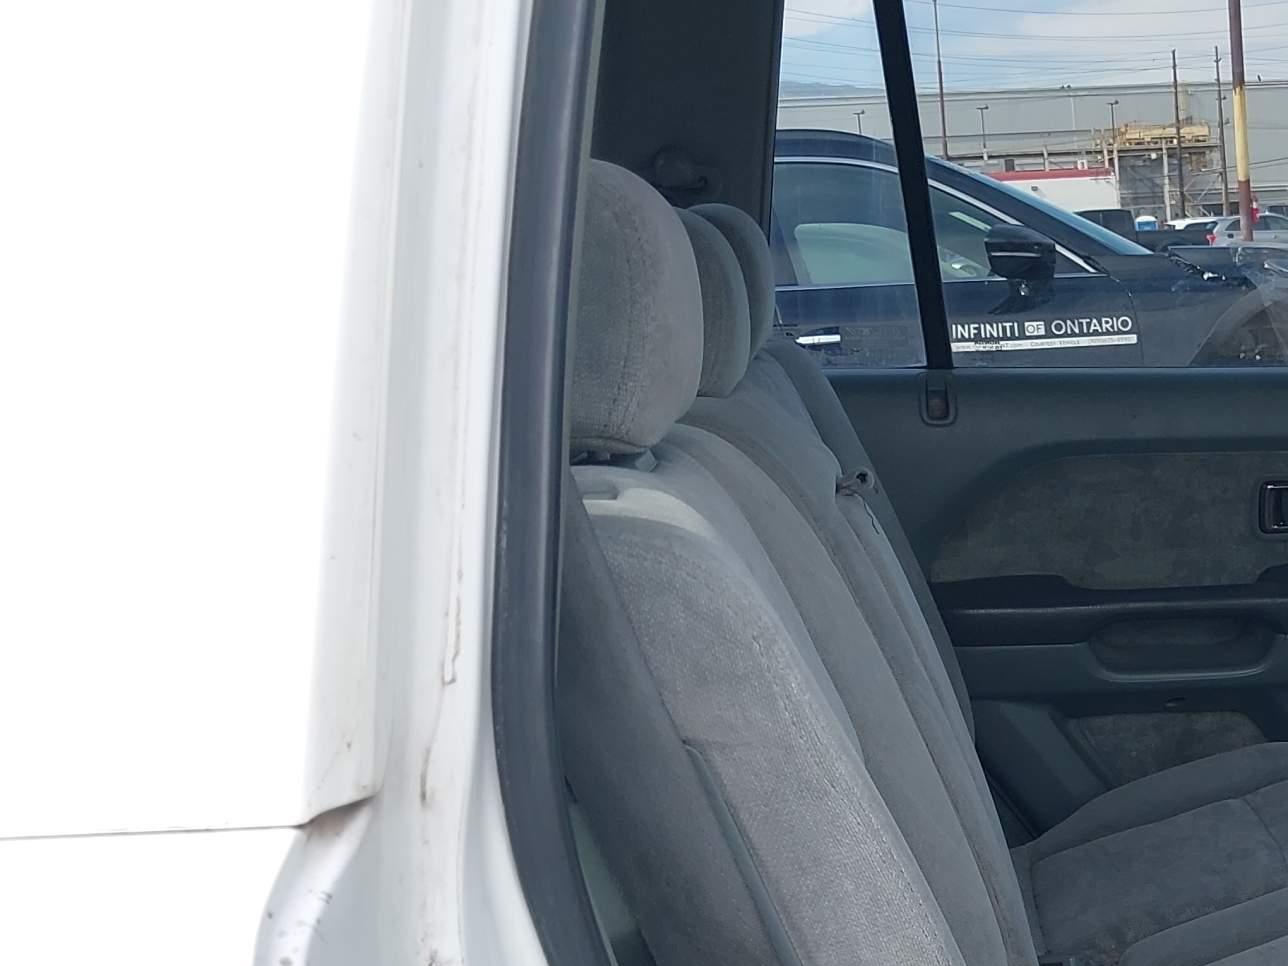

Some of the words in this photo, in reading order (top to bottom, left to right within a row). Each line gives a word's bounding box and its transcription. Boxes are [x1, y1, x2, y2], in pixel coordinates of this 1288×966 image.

[952, 322, 1019, 339] INFINITI
[1025, 322, 1044, 335] OF
[1051, 316, 1132, 335] ONTARIO
